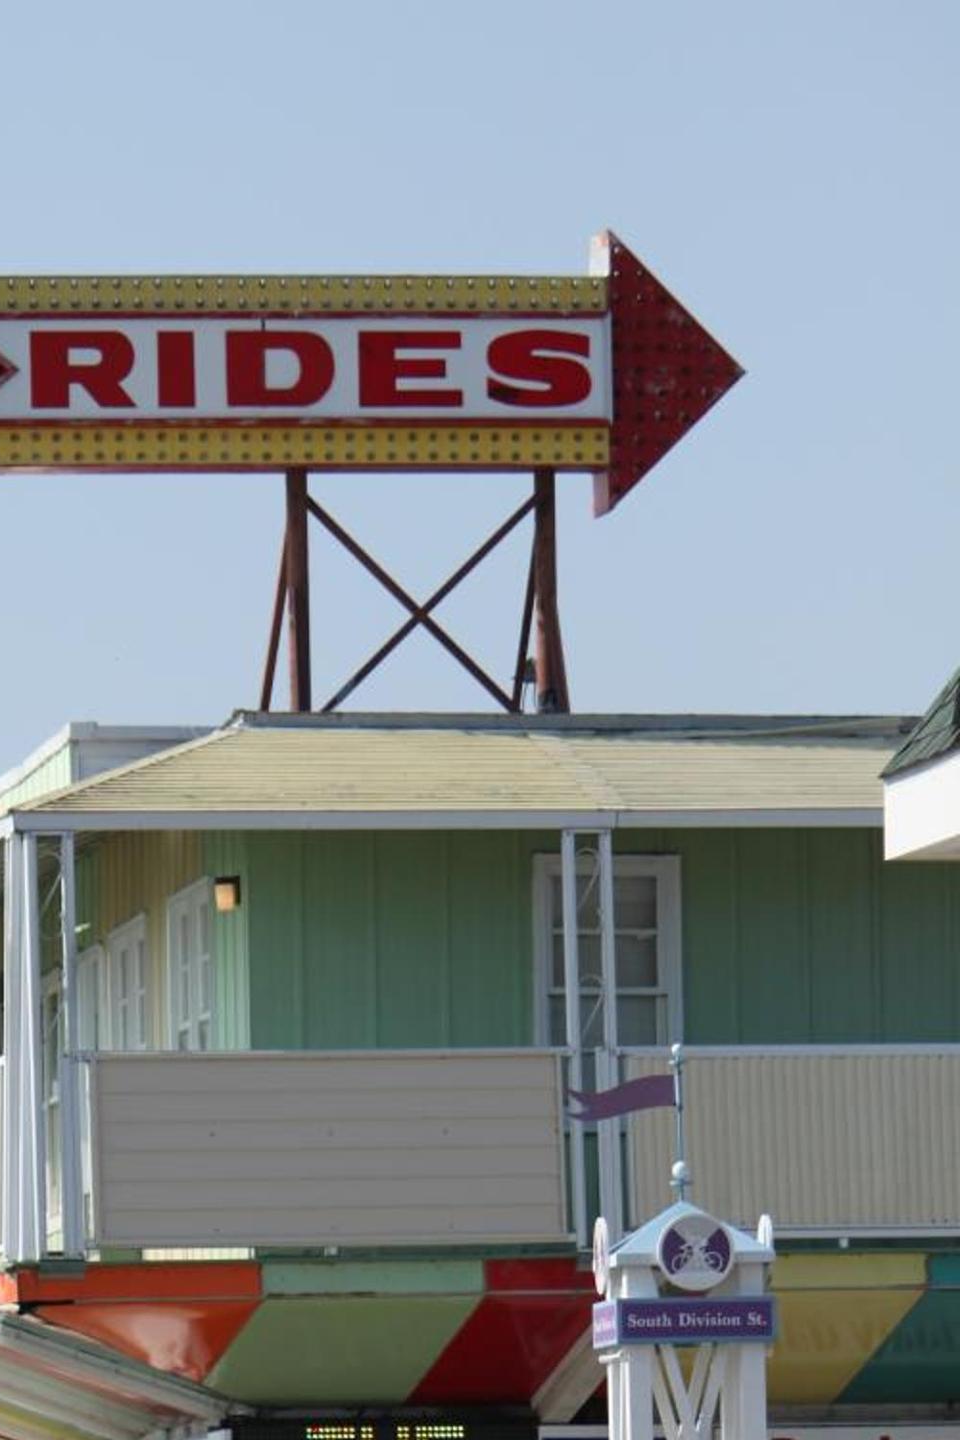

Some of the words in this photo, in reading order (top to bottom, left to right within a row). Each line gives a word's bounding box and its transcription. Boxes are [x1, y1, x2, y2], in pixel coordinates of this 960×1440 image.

[28, 328, 594, 409] RIDES
[627, 1313, 672, 1329] South
[679, 1312, 741, 1328] Division
[747, 1311, 768, 1327] St.
